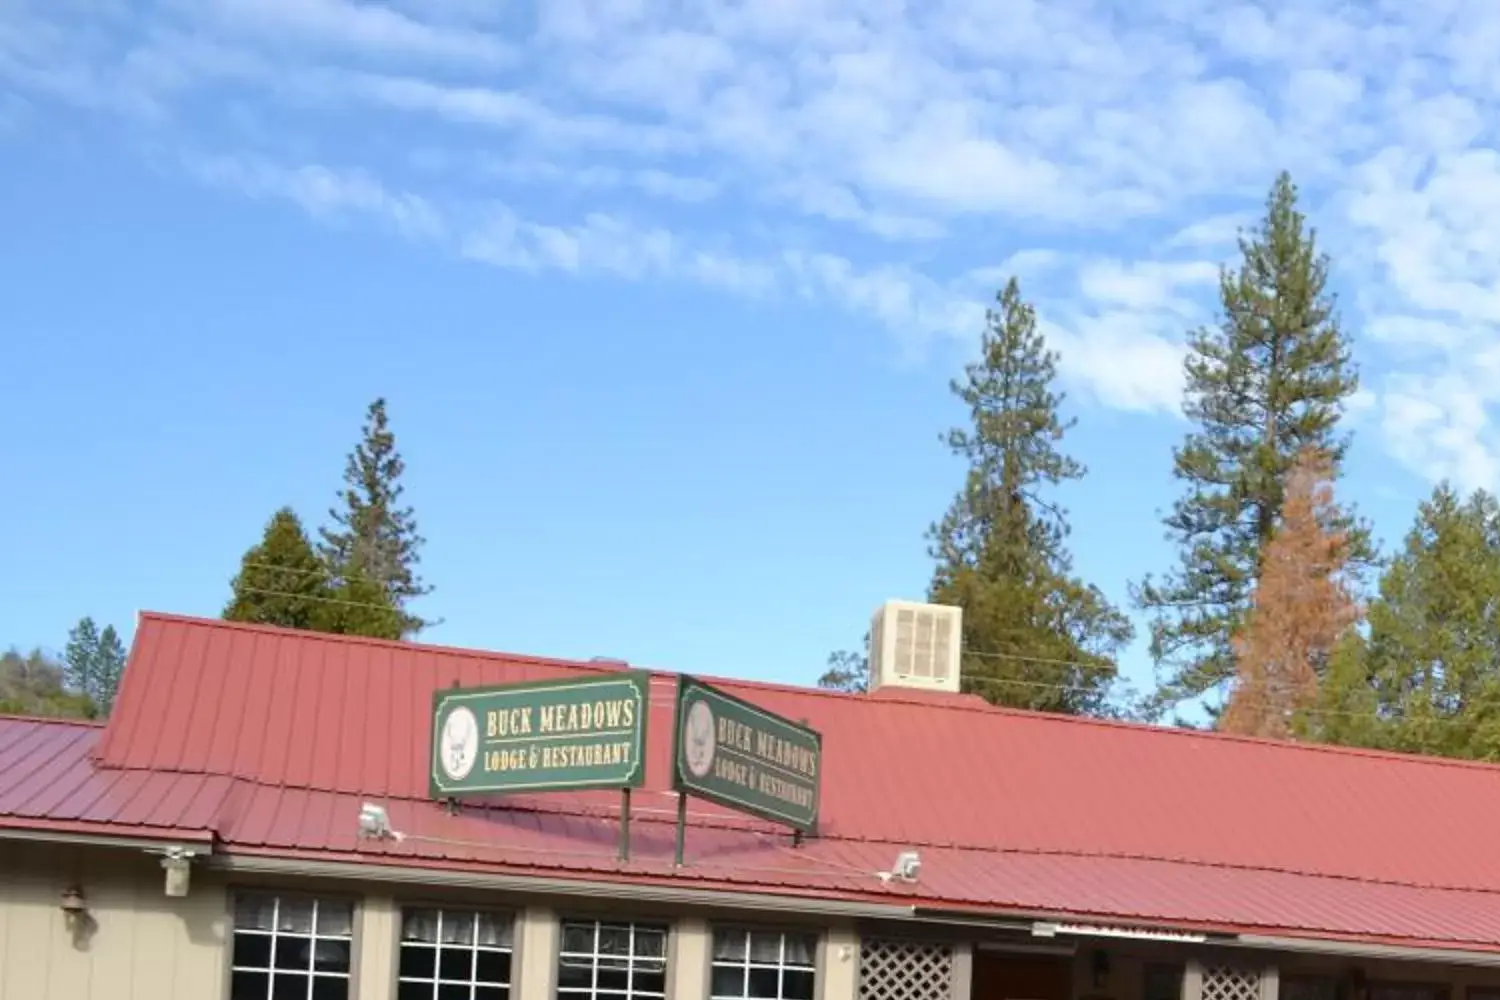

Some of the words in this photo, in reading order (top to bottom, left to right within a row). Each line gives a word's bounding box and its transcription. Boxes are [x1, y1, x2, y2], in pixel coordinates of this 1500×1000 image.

[487, 707, 532, 737] BUCK
[539, 699, 635, 732] MEADOWS
[484, 749, 526, 772] LODGE
[529, 744, 539, 769] &
[543, 742, 631, 768] RESTAURANT
[718, 716, 753, 753] BUCK
[755, 729, 816, 777] MEADOWS
